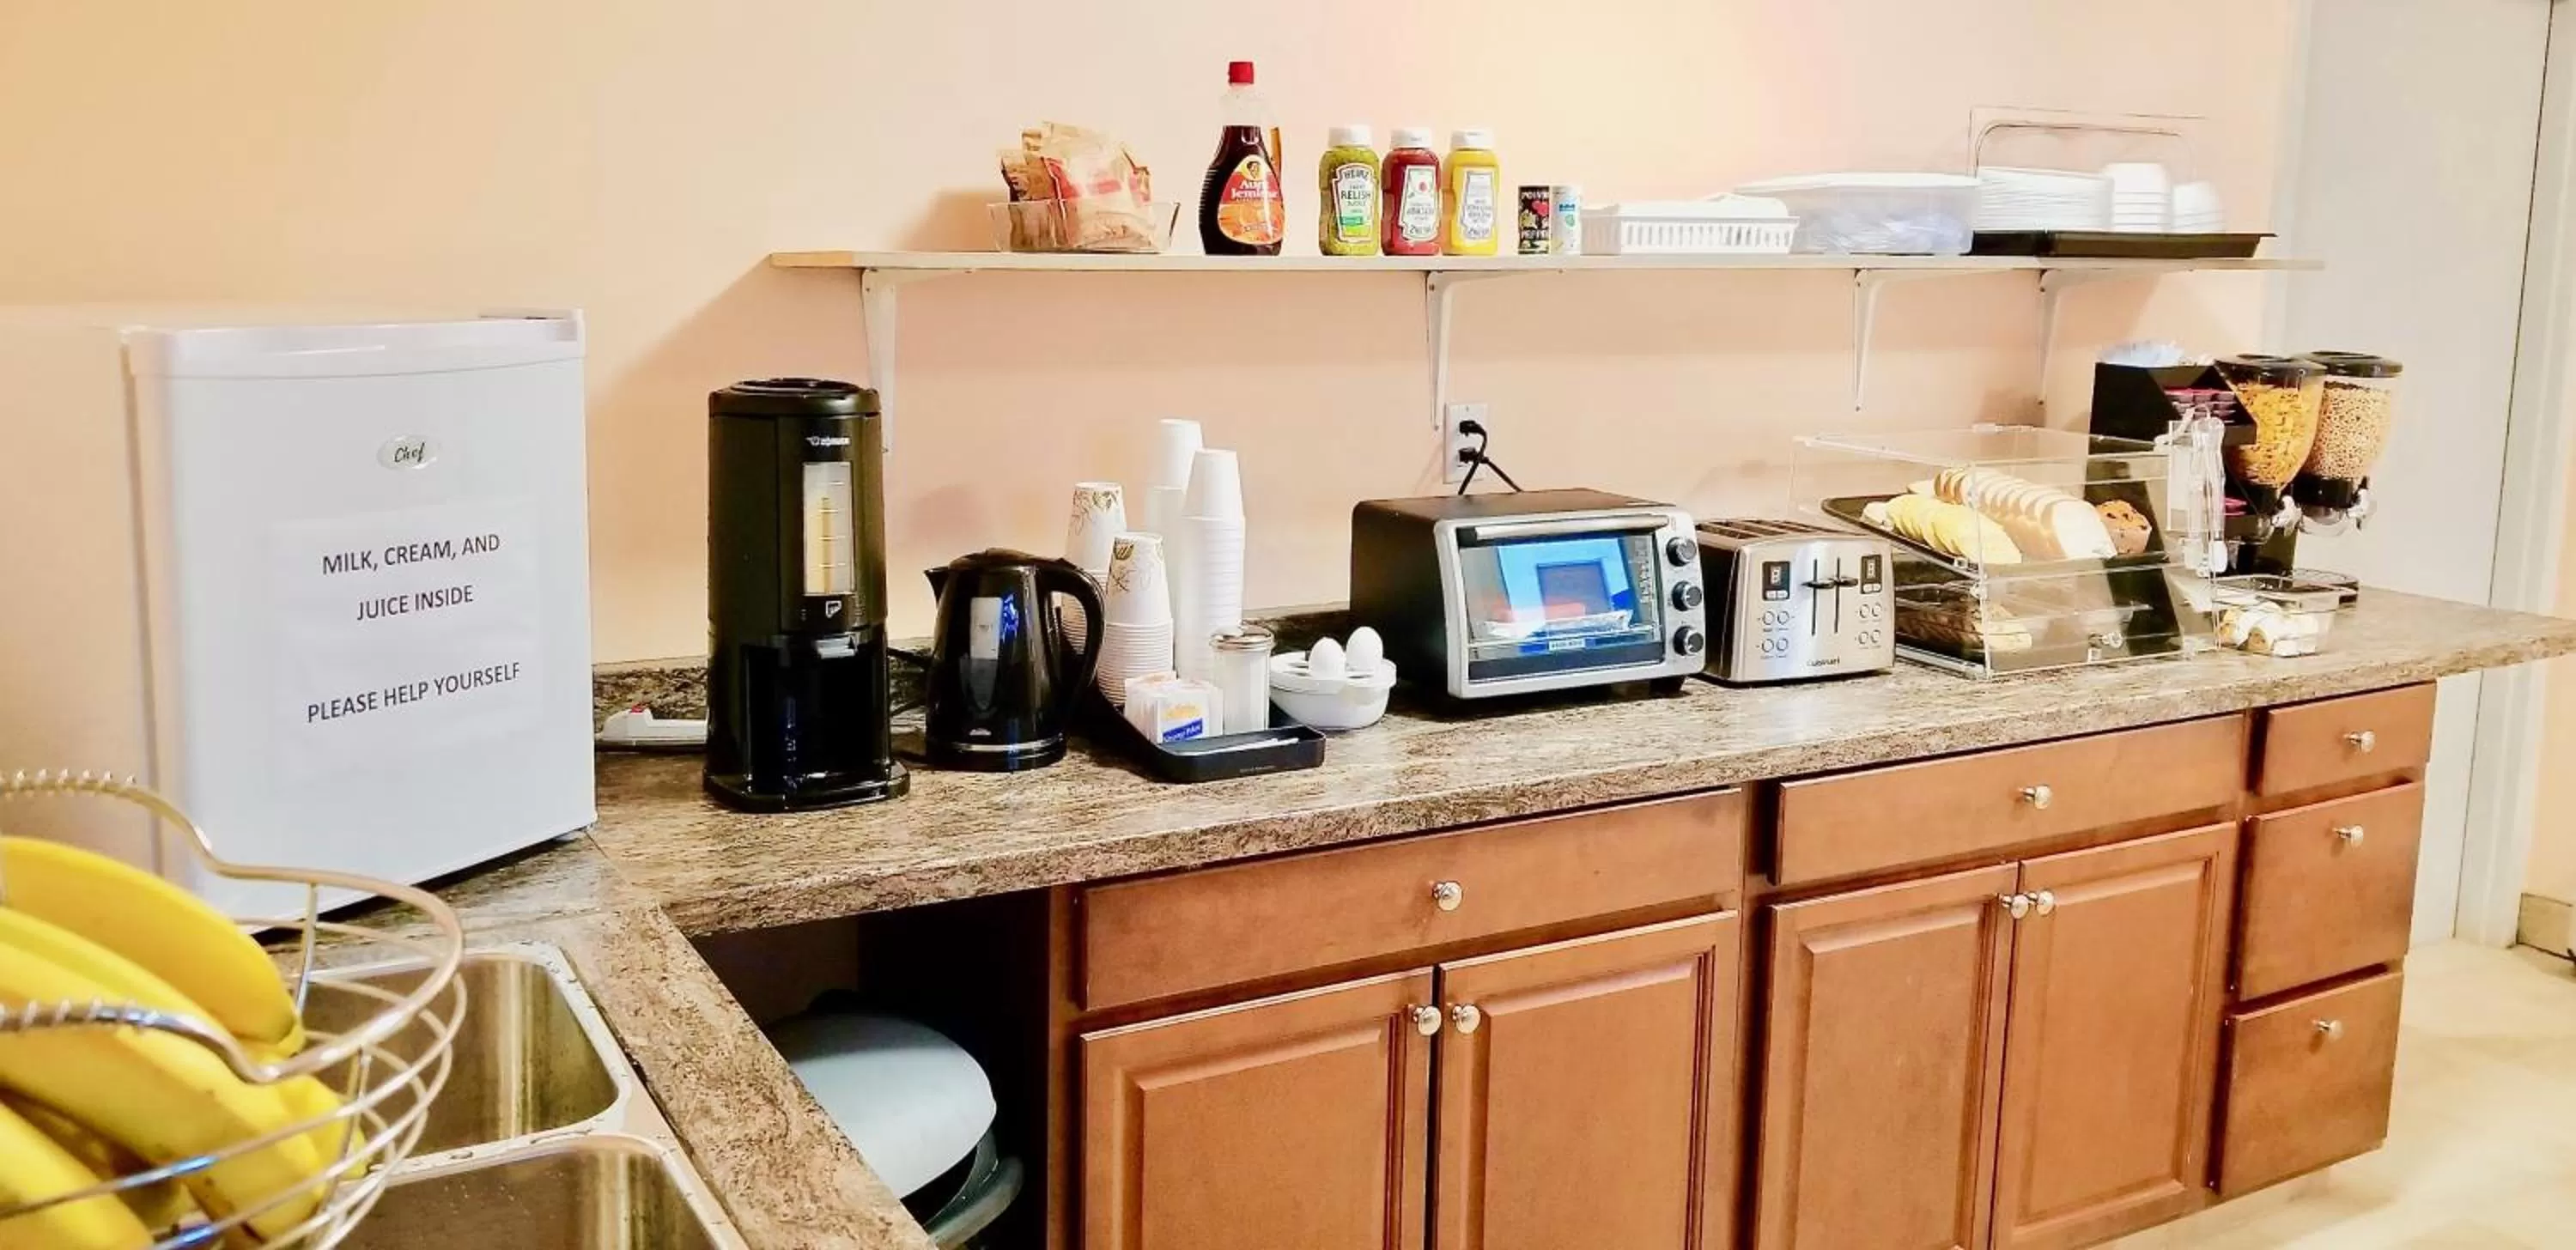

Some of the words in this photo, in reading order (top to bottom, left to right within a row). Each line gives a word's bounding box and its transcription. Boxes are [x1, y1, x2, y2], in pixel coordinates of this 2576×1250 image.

[1340, 190, 1371, 200] RELISH
[394, 441, 425, 463] Chef
[322, 549, 378, 575] MILK,
[384, 540, 457, 567] CREAM,
[462, 533, 501, 556] AND
[356, 594, 410, 621] JUICE
[415, 585, 474, 611] INSIDE
[307, 690, 378, 724] PLEASE
[384, 681, 429, 707] HELP
[434, 662, 520, 697] YOURSELF
